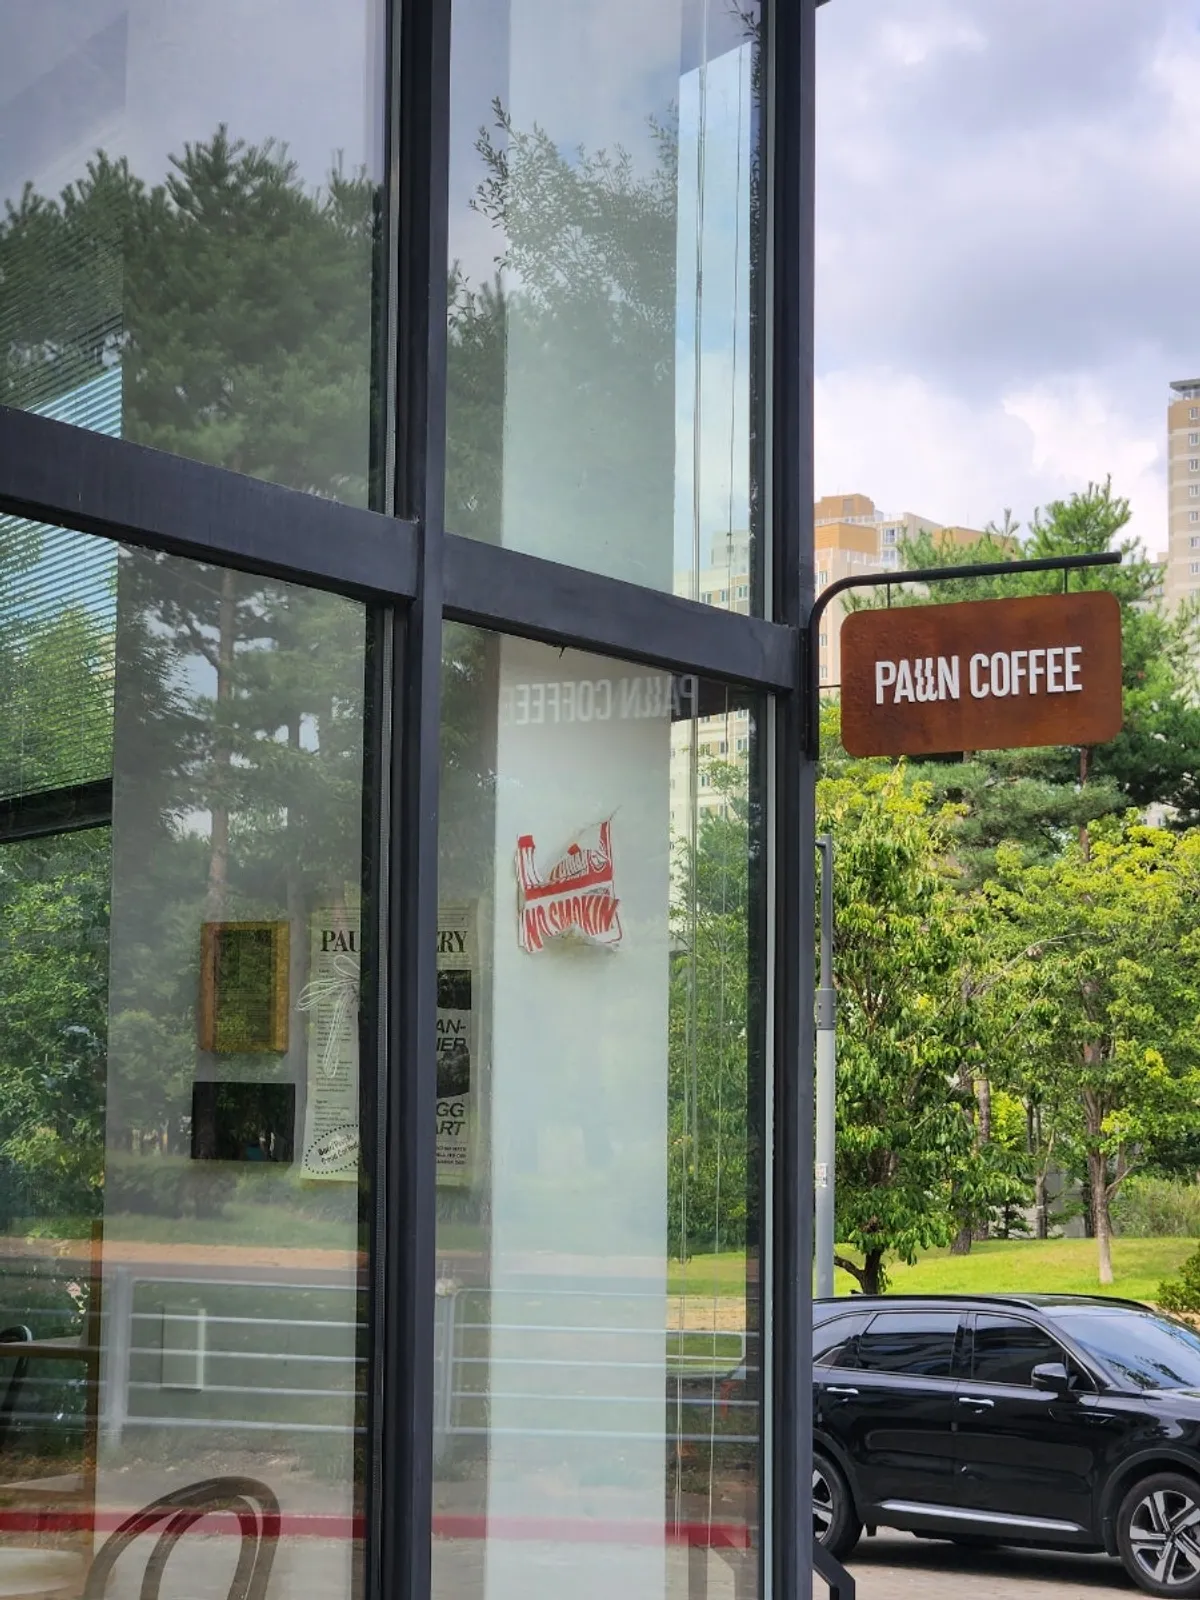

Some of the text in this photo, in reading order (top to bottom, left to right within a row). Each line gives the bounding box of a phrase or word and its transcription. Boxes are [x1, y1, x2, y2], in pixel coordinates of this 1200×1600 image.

[969, 646, 1083, 699] COFFEE
[523, 894, 620, 951] NO SMOKIN
